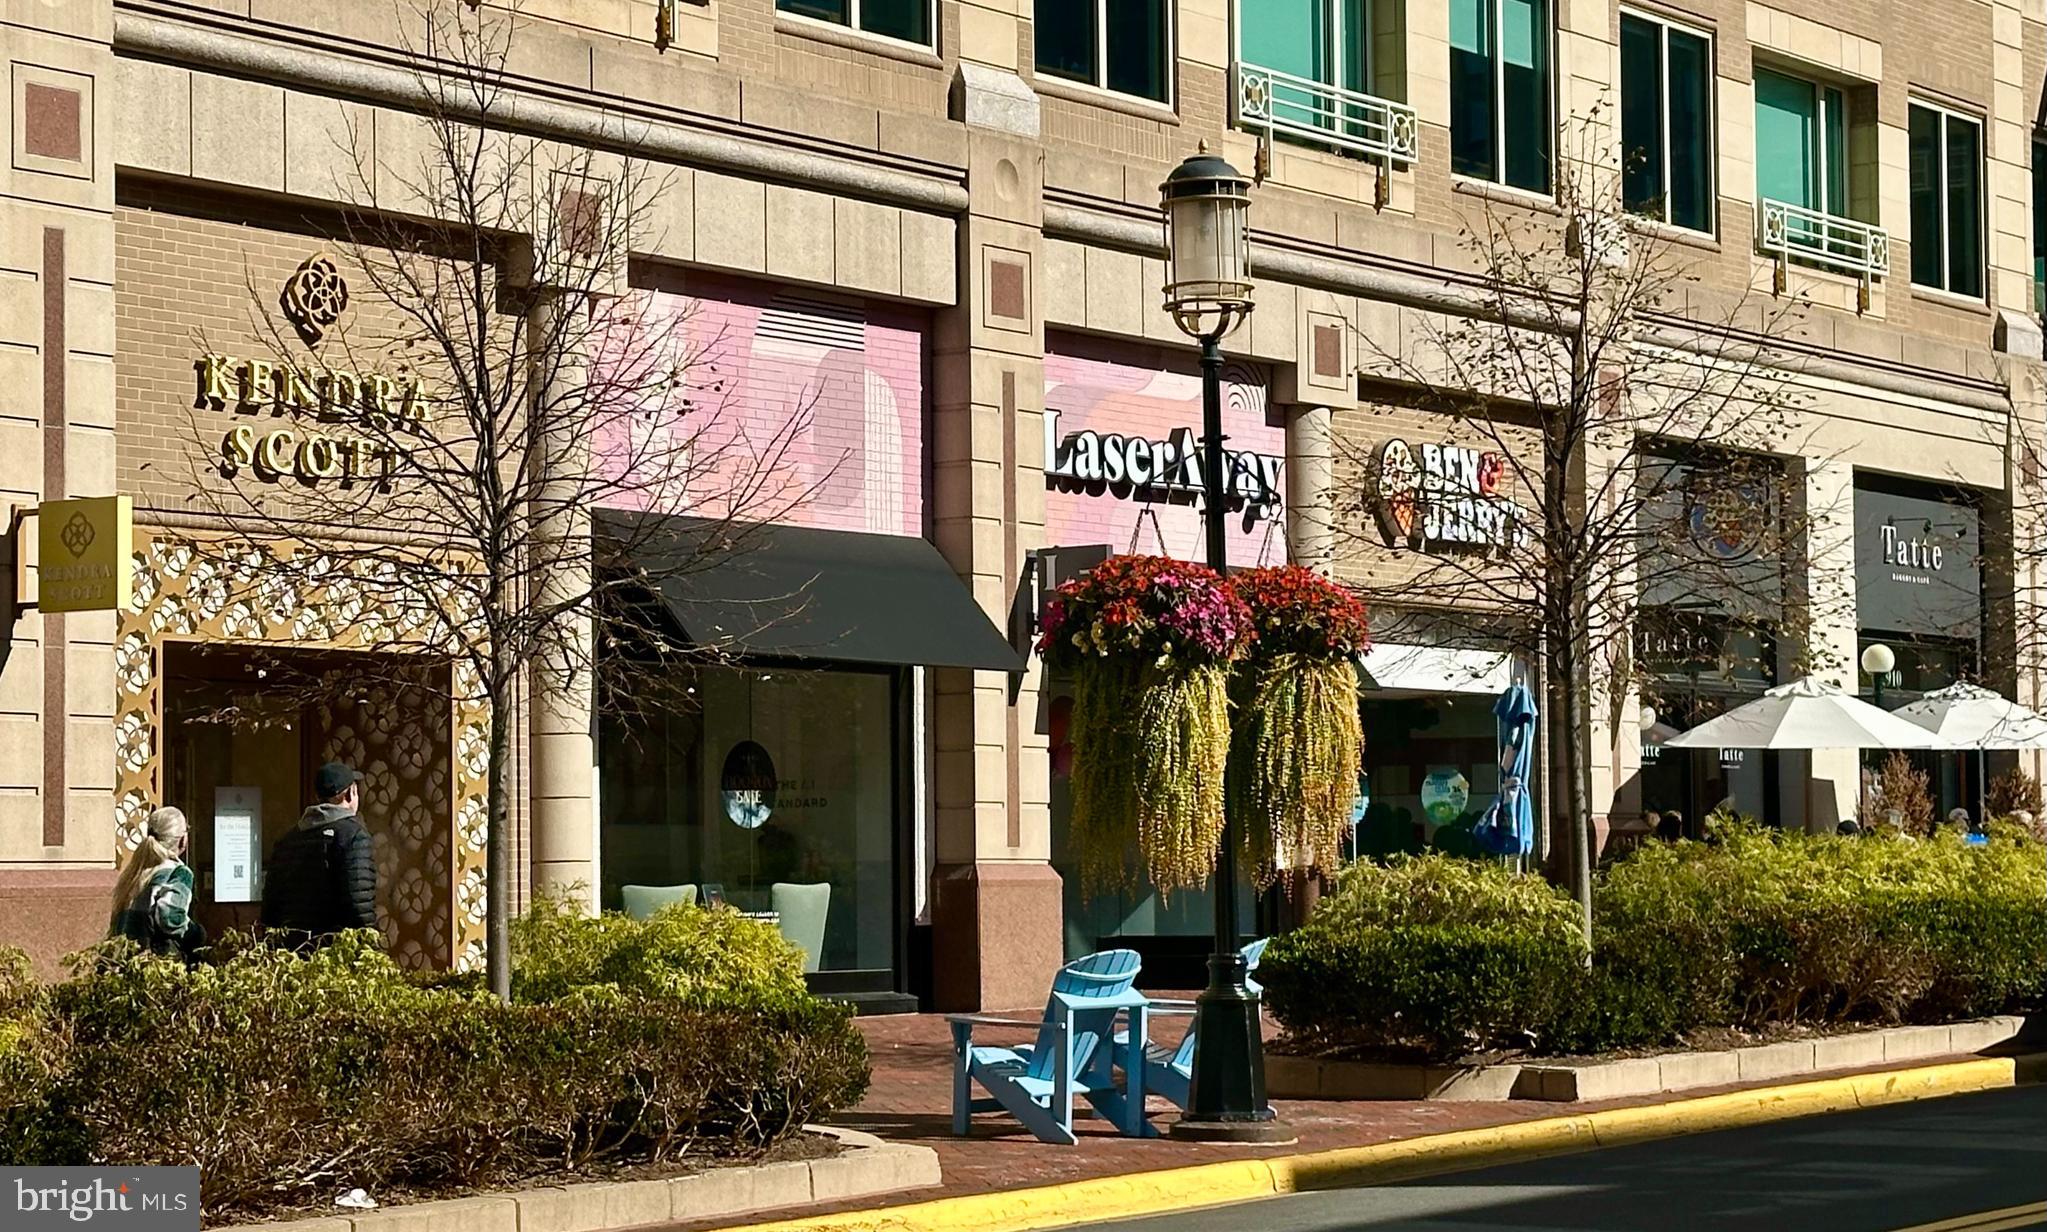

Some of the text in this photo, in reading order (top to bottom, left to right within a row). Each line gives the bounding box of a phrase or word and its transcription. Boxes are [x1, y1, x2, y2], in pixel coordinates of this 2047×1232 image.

[200, 353, 433, 424] KENDRA
[225, 424, 411, 482] SCOTT
[1422, 442, 1480, 494] BEN
[1880, 525, 1943, 570] Tatte
[44, 564, 113, 580] KENDRA
[48, 583, 106, 601] SCOTT
